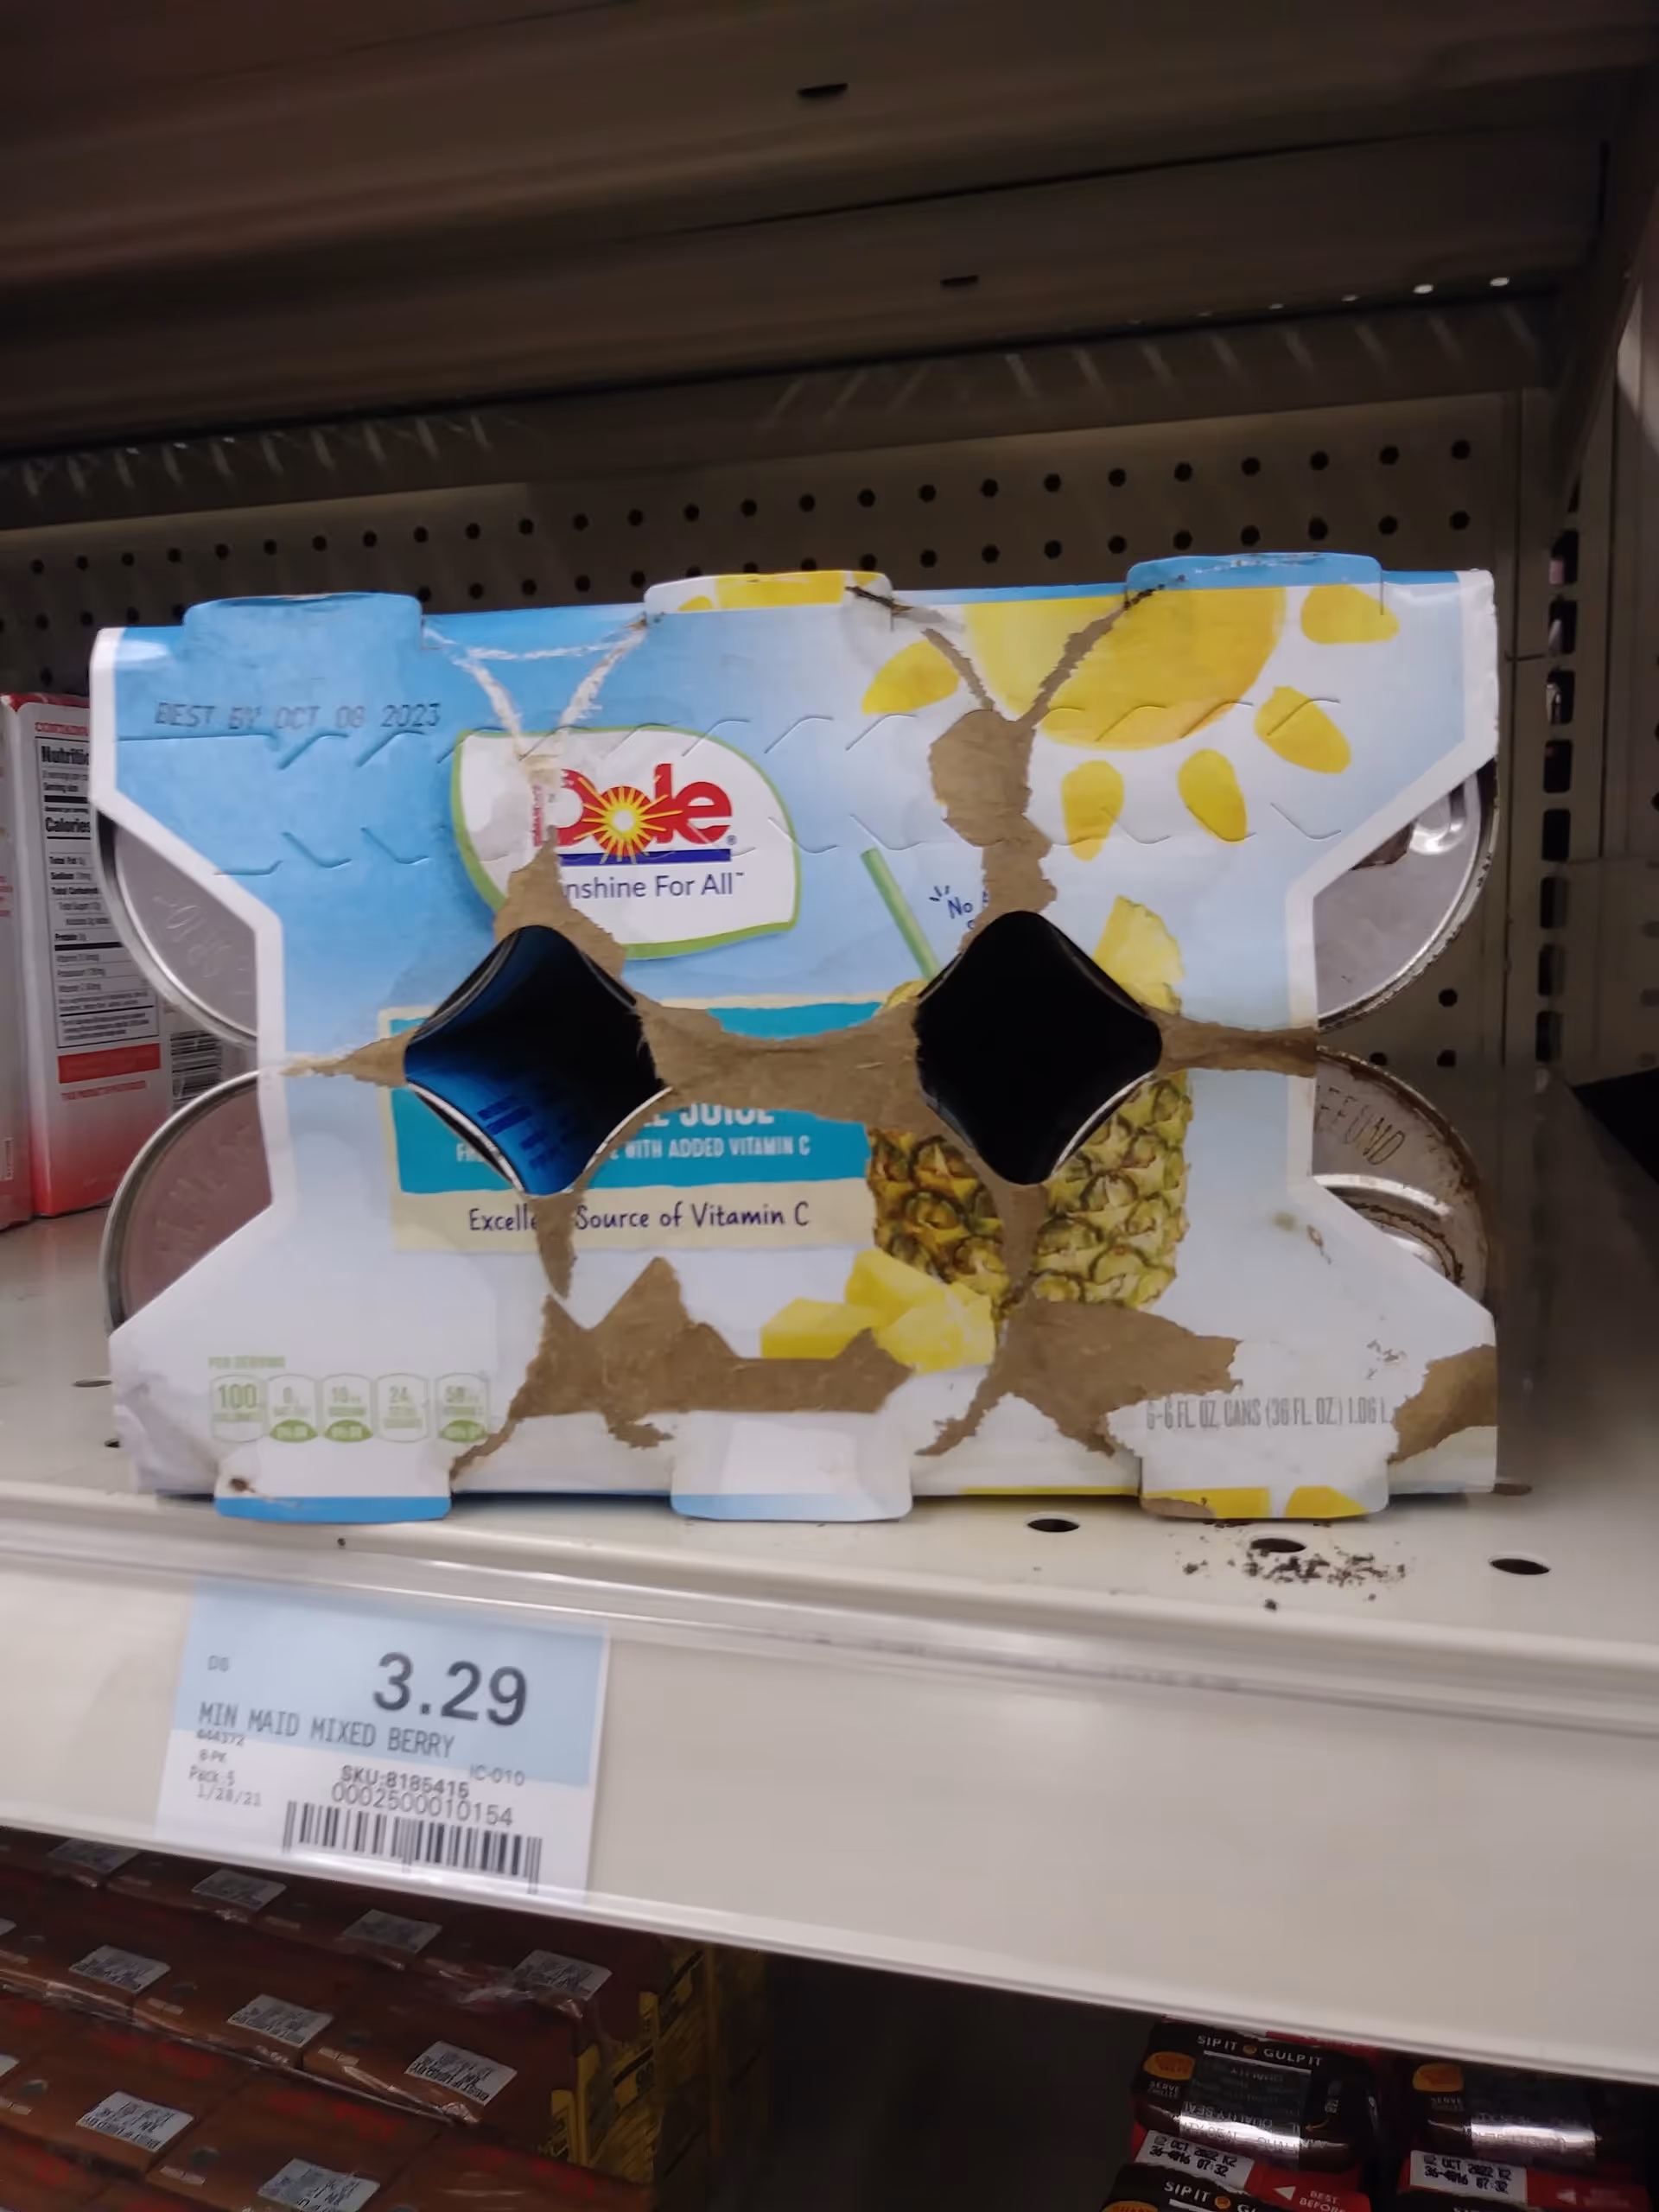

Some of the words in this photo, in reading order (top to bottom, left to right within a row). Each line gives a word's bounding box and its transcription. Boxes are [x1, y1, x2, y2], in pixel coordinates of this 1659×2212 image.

[154, 702, 215, 727] BEST
[273, 705, 321, 729] OCT
[380, 702, 442, 728] 2023
[564, 875, 648, 900] nshine
[655, 874, 696, 898] For
[625, 1140, 664, 1160] WITH
[668, 1137, 725, 1159] ADDED
[728, 1135, 794, 1156] VITAMIN
[798, 1135, 811, 1156] C
[468, 1204, 537, 1232] Excelle
[575, 1205, 650, 1230] Source
[658, 1200, 684, 1228] of
[690, 1202, 786, 1229] Vitamin
[794, 1202, 810, 1227] C
[1224, 1398, 1262, 1427] CANS
[372, 1651, 529, 1727] 3.29
[198, 1700, 239, 1729] MIN
[247, 1708, 301, 1737] MAID
[309, 1716, 377, 1750] MIXED
[386, 1726, 456, 1760] BERRY
[331, 1781, 514, 1827] 0002500010154
[1197, 2035, 1222, 2049] SIP
[1223, 2040, 1238, 2052] IT
[1262, 2047, 1306, 2066] GULP
[1163, 2180, 1193, 2197] SIP
[1194, 2189, 1211, 2202] IT
